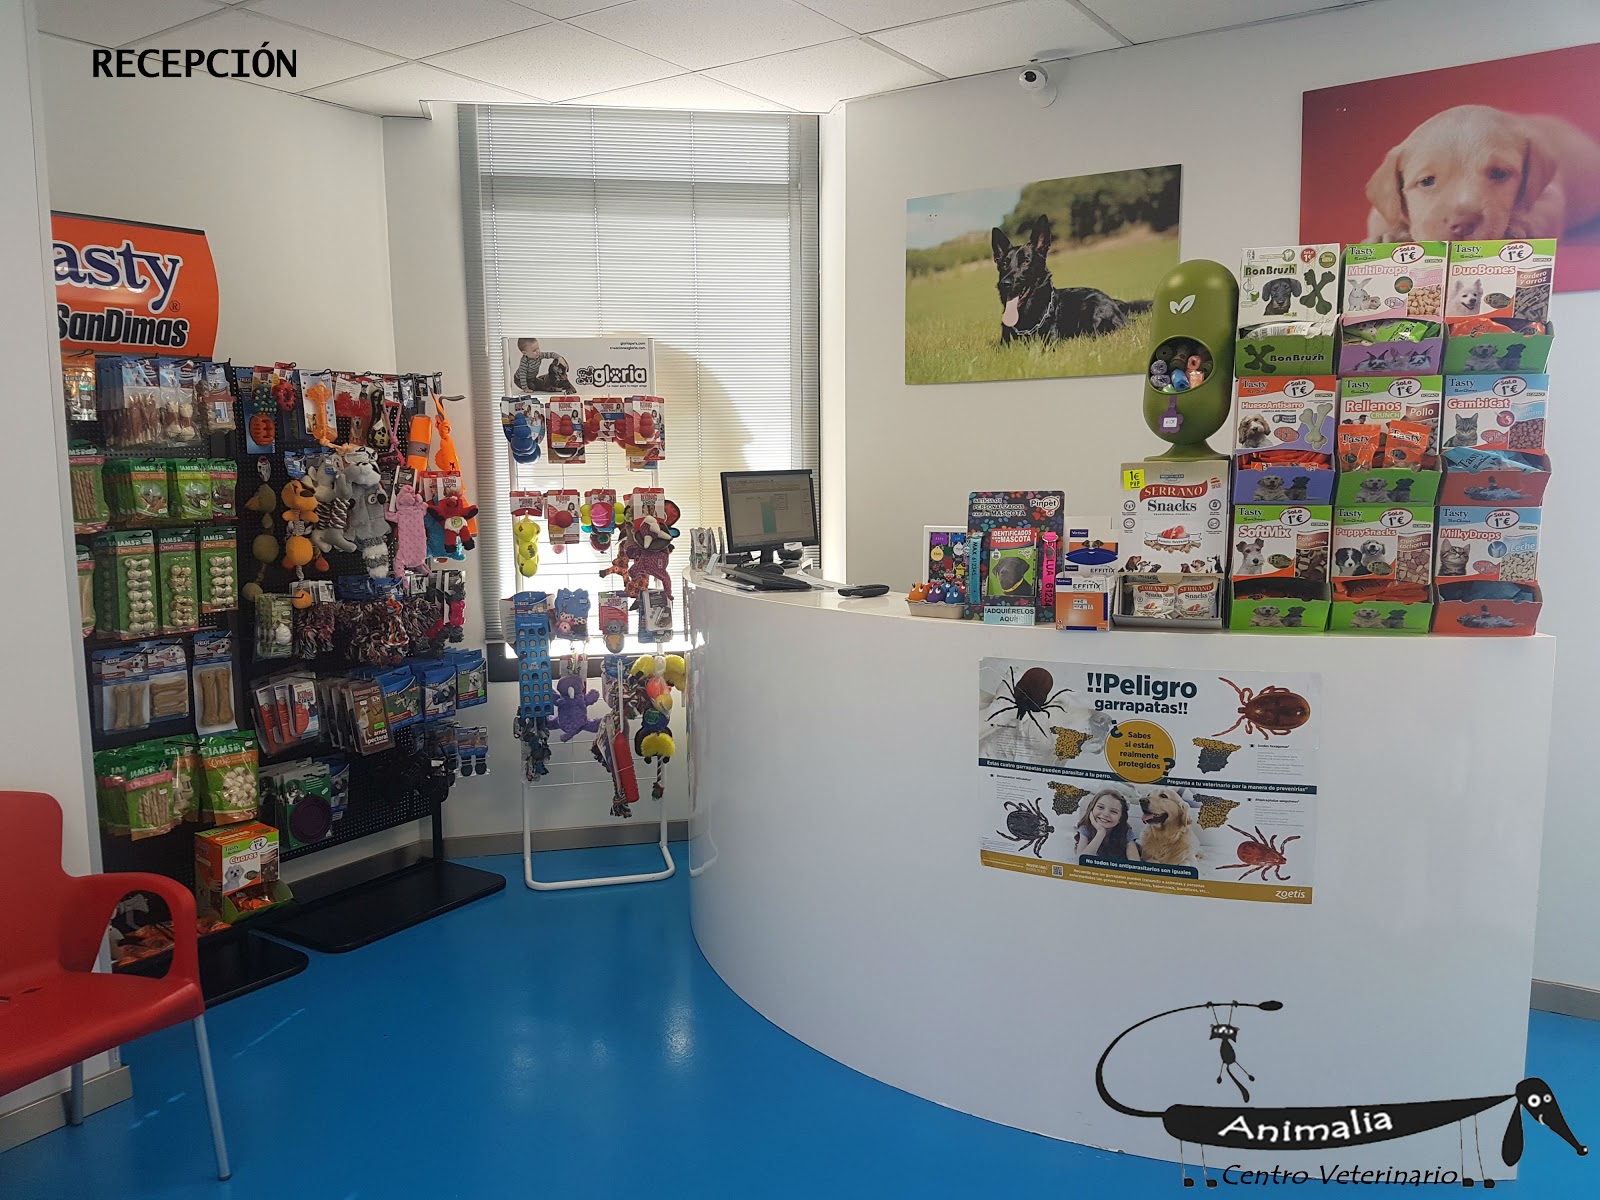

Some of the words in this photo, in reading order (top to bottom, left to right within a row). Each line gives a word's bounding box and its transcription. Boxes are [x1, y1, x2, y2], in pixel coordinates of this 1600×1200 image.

[1349, 246, 1374, 256] Tasty
[1455, 244, 1482, 254] Tasty
[1245, 265, 1296, 276] BonBrush
[1348, 265, 1408, 276] MultiDrops
[1452, 264, 1516, 276] DuoBones
[1242, 380, 1268, 389] Tasty
[1346, 380, 1371, 390] Tasty
[1449, 379, 1476, 388] Tasty
[1242, 401, 1304, 410] HuesoAntisarro
[1346, 400, 1402, 412] Rellenos
[1448, 398, 1510, 409] GambiCat
[1410, 407, 1434, 416] Pollo
[1341, 434, 1370, 444] Tasty
[1392, 428, 1422, 444] Tasty
[1130, 471, 1140, 480] 1€
[1144, 486, 1202, 496] SERRANO
[1030, 499, 1057, 508] Pinpet
[1148, 500, 1197, 512] Snacks
[1238, 508, 1263, 517] Tasty
[1338, 509, 1362, 518] Tasty
[1443, 509, 1468, 519] Tasty
[1239, 525, 1291, 538] SoftMix
[1336, 528, 1396, 538] PuppySnacks
[1440, 529, 1501, 542] MilkyDrops
[118, 538, 134, 547] IAMS
[1510, 542, 1536, 552] Leche
[1046, 560, 1054, 576] LUA
[1179, 584, 1213, 593] SERRANO
[1087, 672, 1198, 700] !!Peligro
[1094, 700, 1188, 714] garrapatas!!
[368, 734, 388, 745] pectoral
[209, 745, 234, 756] IAMS
[1120, 751, 1160, 759] realmente
[1118, 760, 1161, 770] protegidos
[130, 768, 151, 779] IAMS
[1016, 764, 1041, 772] garrapatas
[1062, 768, 1084, 777] parasitar
[229, 852, 258, 864] Cuores
[1119, 862, 1160, 873] antiparasitarios
[1275, 890, 1305, 899] zoetis
